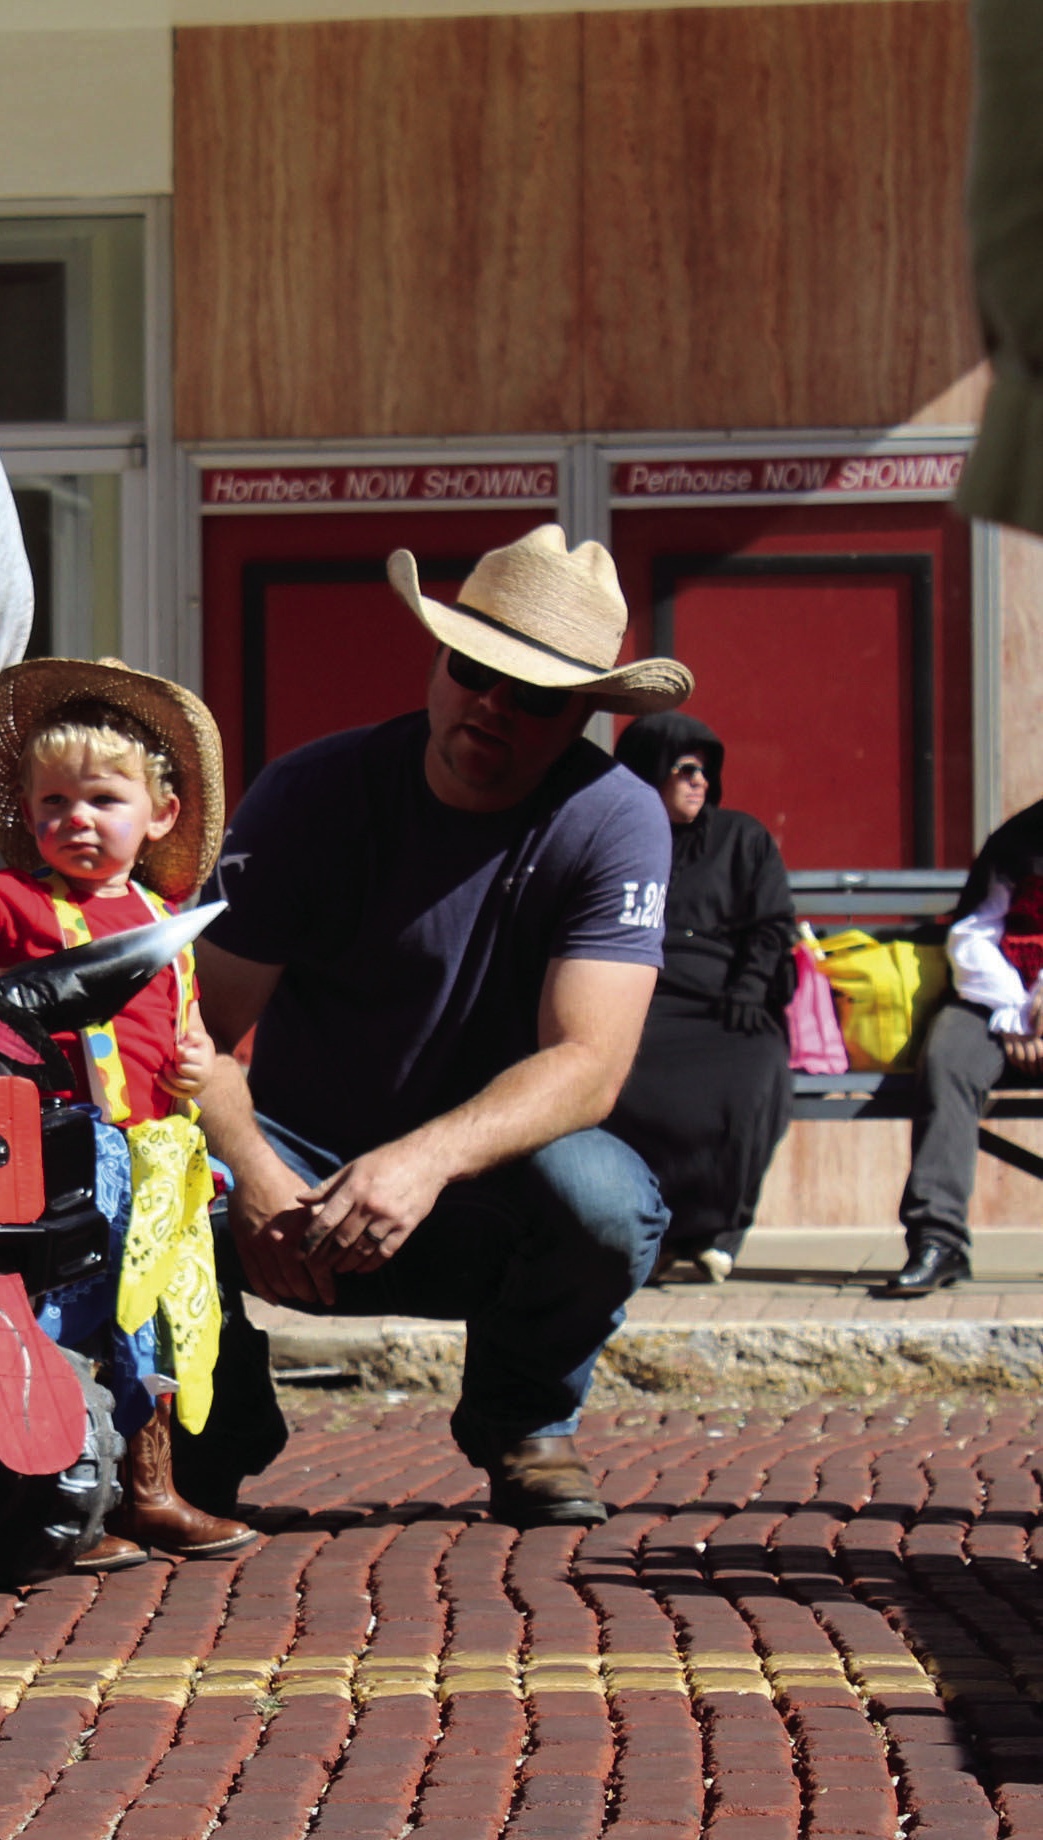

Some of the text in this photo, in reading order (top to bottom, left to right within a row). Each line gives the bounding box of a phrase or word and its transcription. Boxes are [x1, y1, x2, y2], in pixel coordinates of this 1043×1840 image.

[213, 466, 554, 502] Hornbeck NOW SHOWING
[762, 462, 831, 490] NOW
[838, 456, 964, 490] SHOWING
